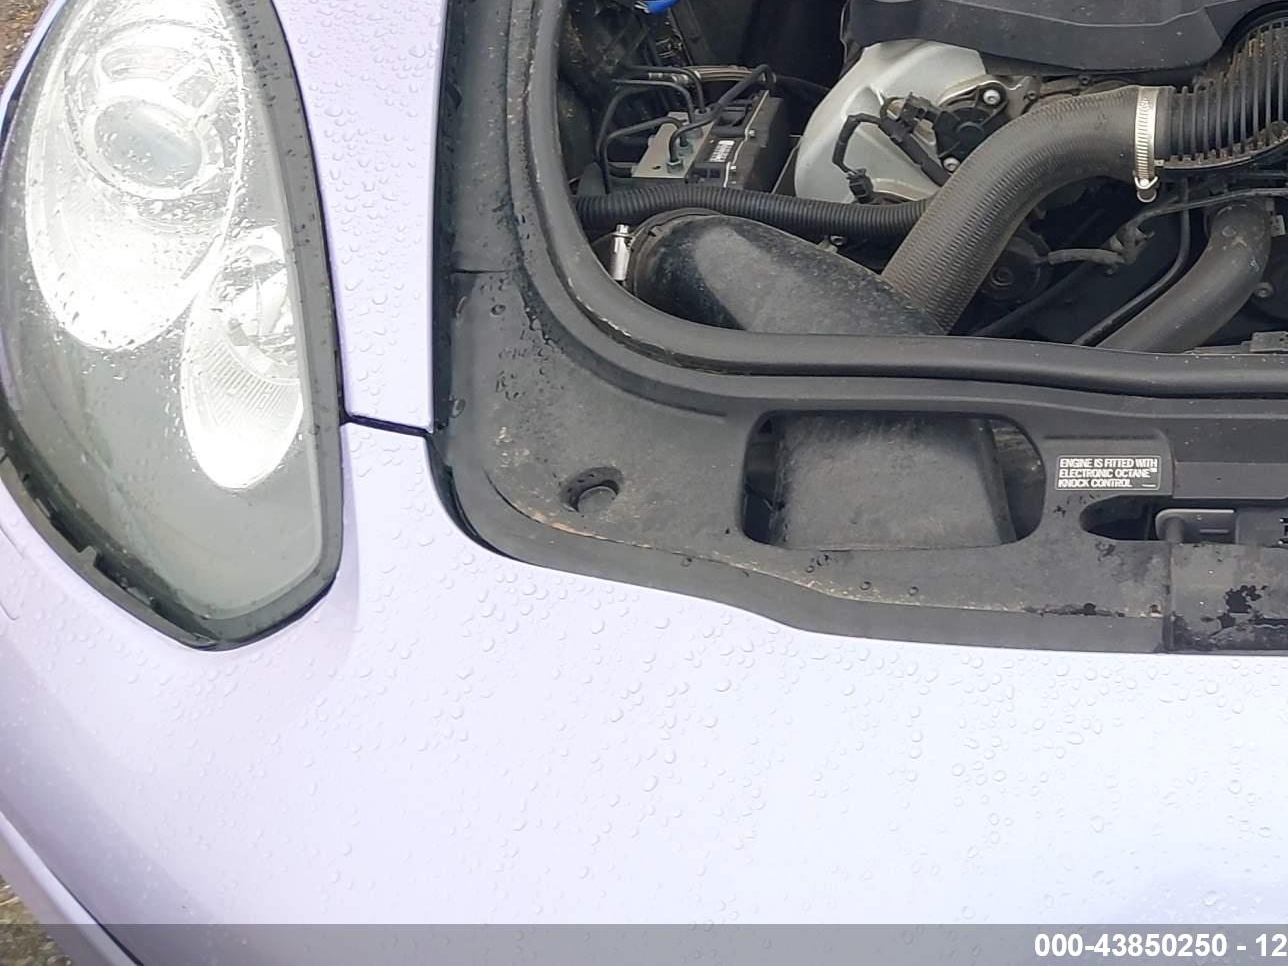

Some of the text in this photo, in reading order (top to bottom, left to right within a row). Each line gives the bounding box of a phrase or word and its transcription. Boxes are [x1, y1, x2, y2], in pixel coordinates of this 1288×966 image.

[1060, 458, 1158, 468] ENGINE IS FITTED WITH
[1059, 468, 1113, 478] ELECTRONIC
[1058, 478, 1133, 488] KNOCK CONTROL
